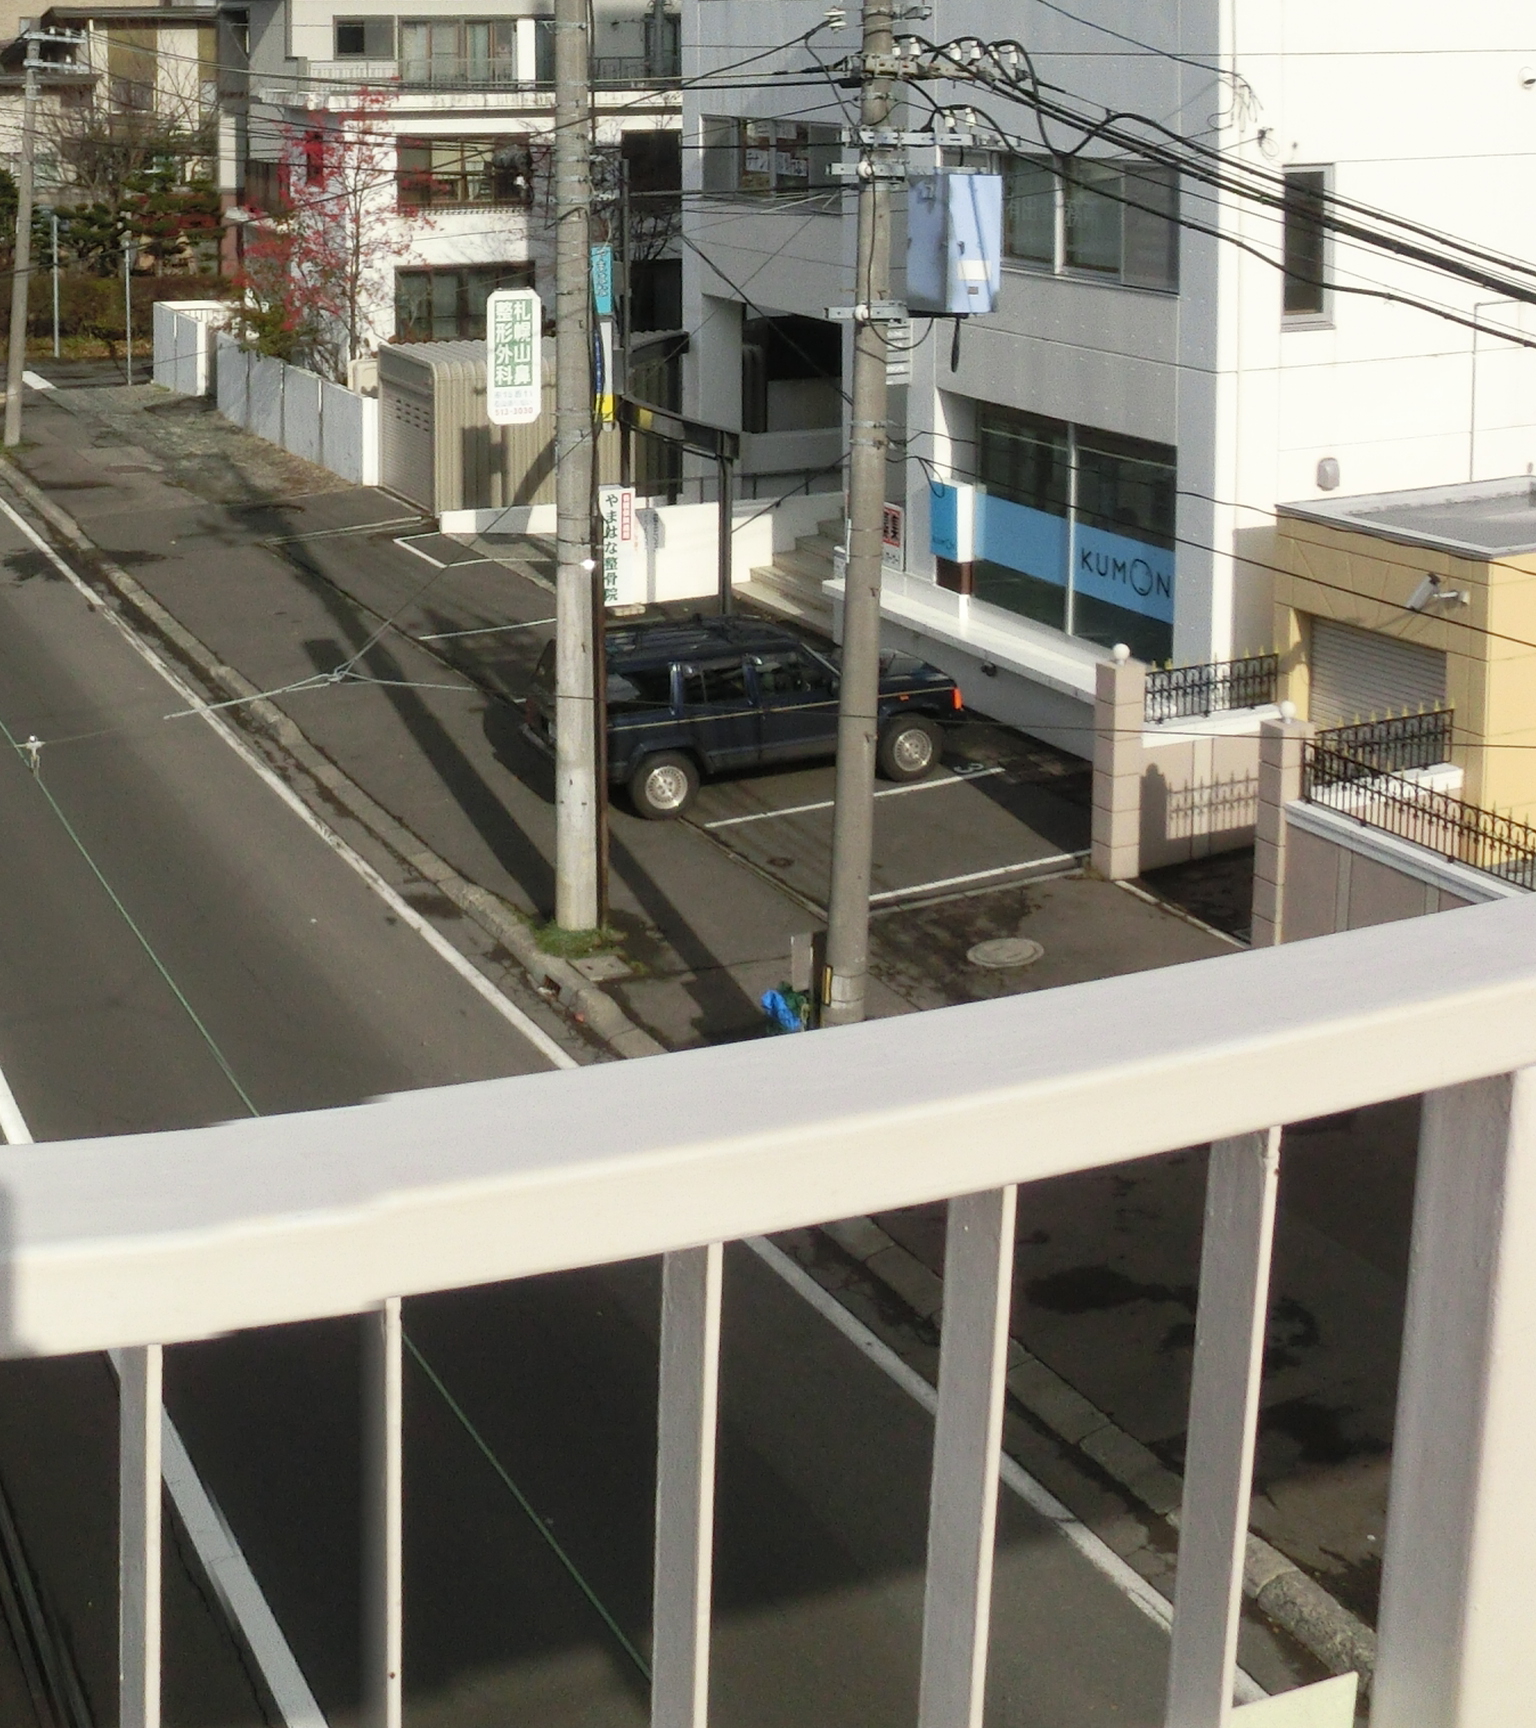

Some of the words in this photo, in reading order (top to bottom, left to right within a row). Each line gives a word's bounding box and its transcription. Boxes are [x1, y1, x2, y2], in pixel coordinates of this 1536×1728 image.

[494, 301, 513, 386] 整形外科
[513, 300, 532, 385] 札幌山鼻
[603, 493, 619, 603] やまはな整骨院
[1081, 547, 1172, 600] KUMON
